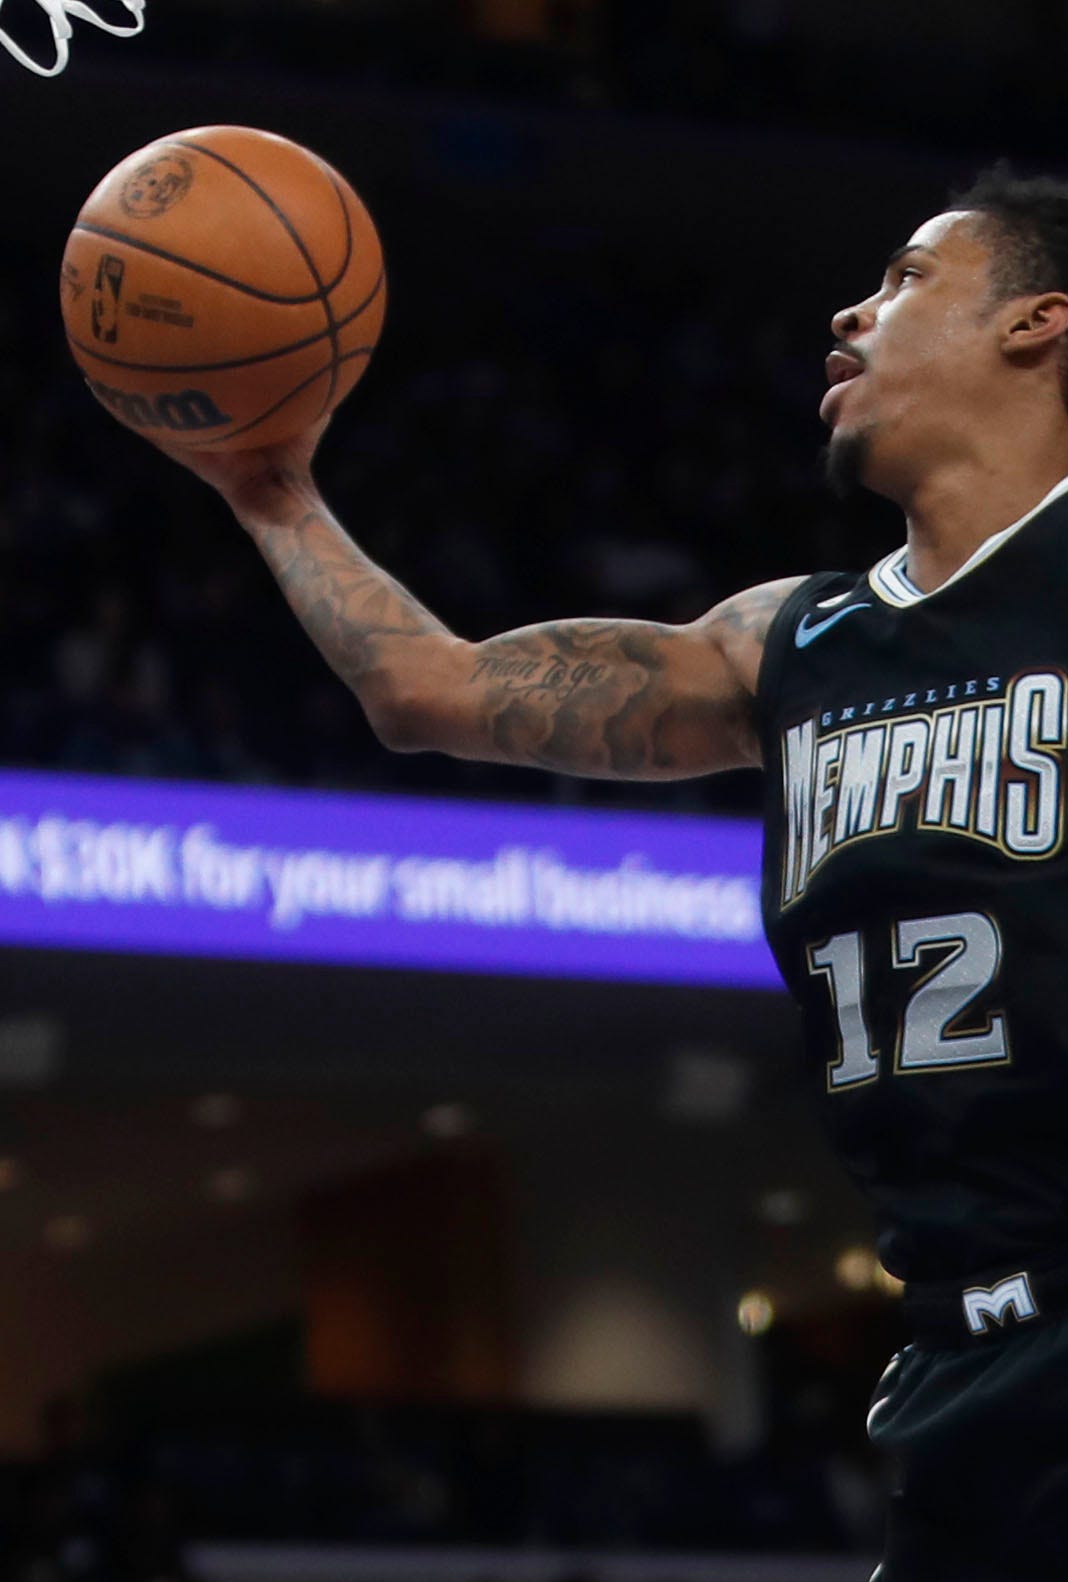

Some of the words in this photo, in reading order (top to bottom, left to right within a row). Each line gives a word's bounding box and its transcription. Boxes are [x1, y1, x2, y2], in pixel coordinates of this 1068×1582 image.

[820, 676, 1001, 726] GRIZZLIES
[181, 822, 263, 908] for
[265, 848, 388, 931] your
[806, 911, 1011, 1094] 12
[962, 1271, 1040, 1336] M
